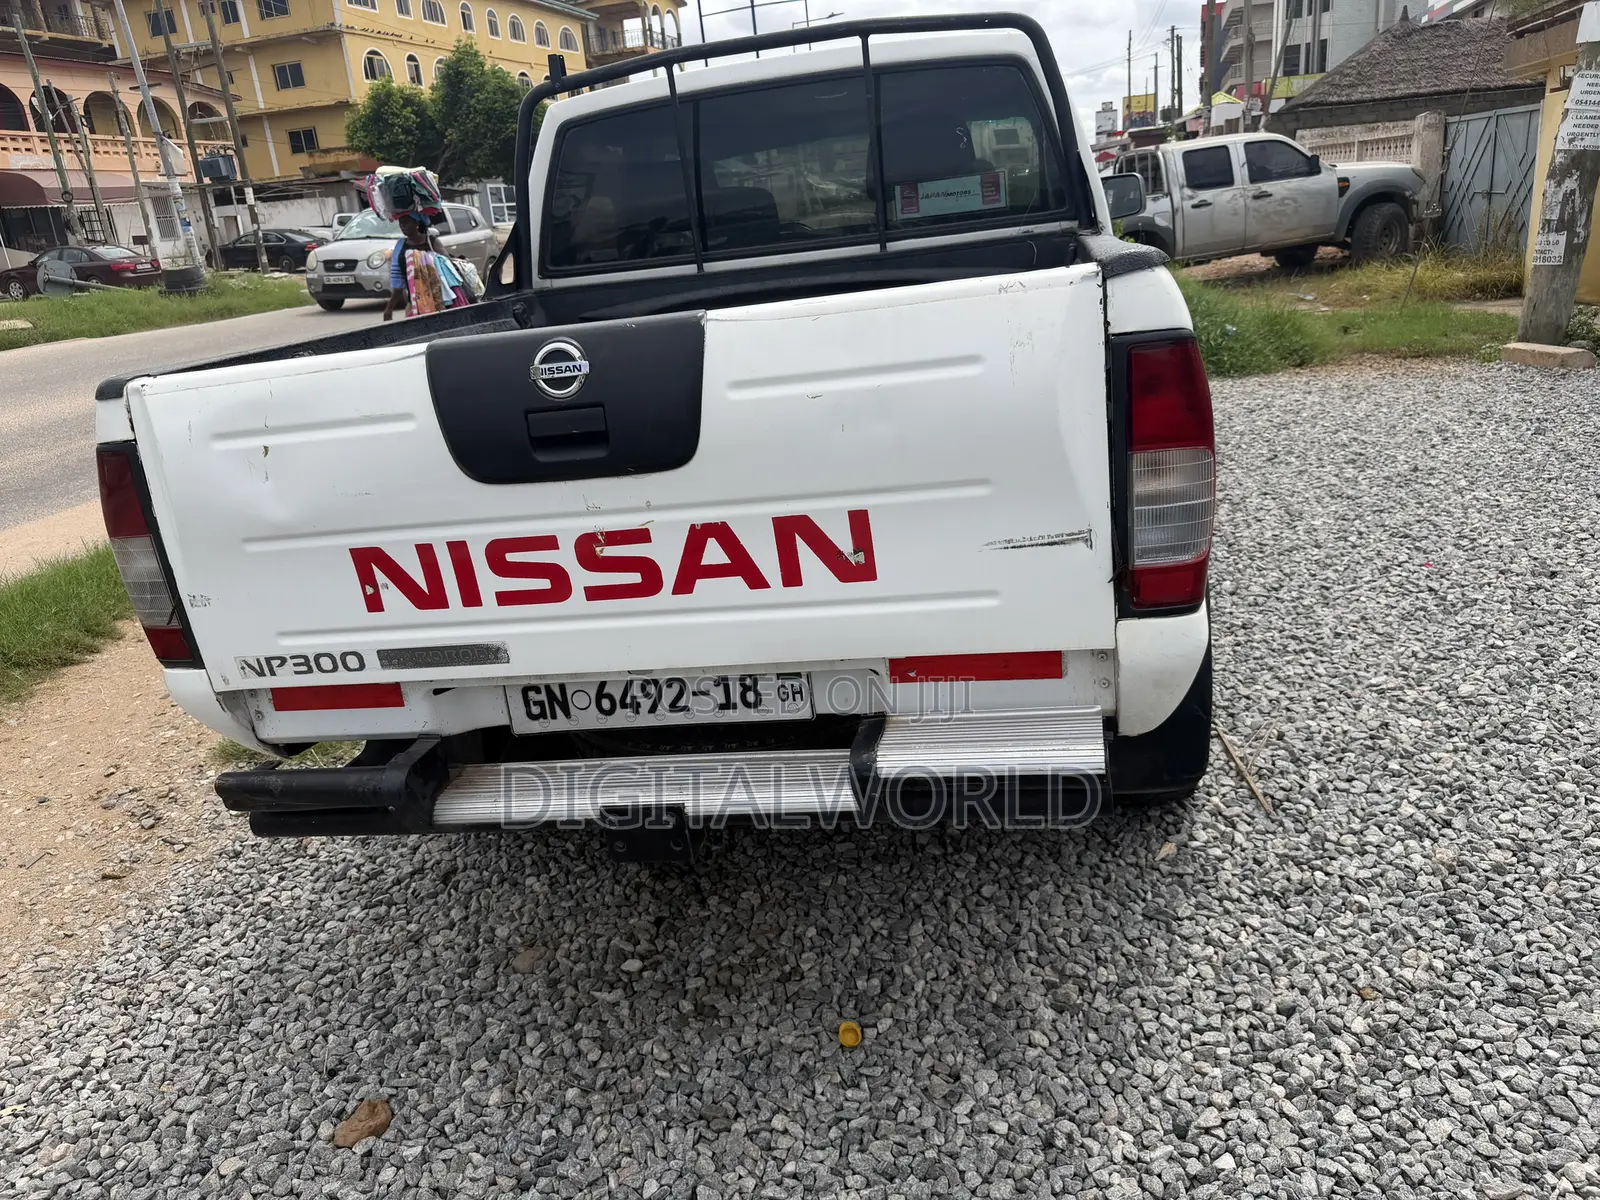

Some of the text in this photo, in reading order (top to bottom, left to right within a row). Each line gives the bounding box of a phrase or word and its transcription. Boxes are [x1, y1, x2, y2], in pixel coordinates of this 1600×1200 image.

[348, 508, 878, 613] NISSAN
[239, 650, 367, 678] NP300
[521, 682, 572, 721] GN
[594, 675, 763, 717] 6492-18
[777, 683, 805, 703] GH
